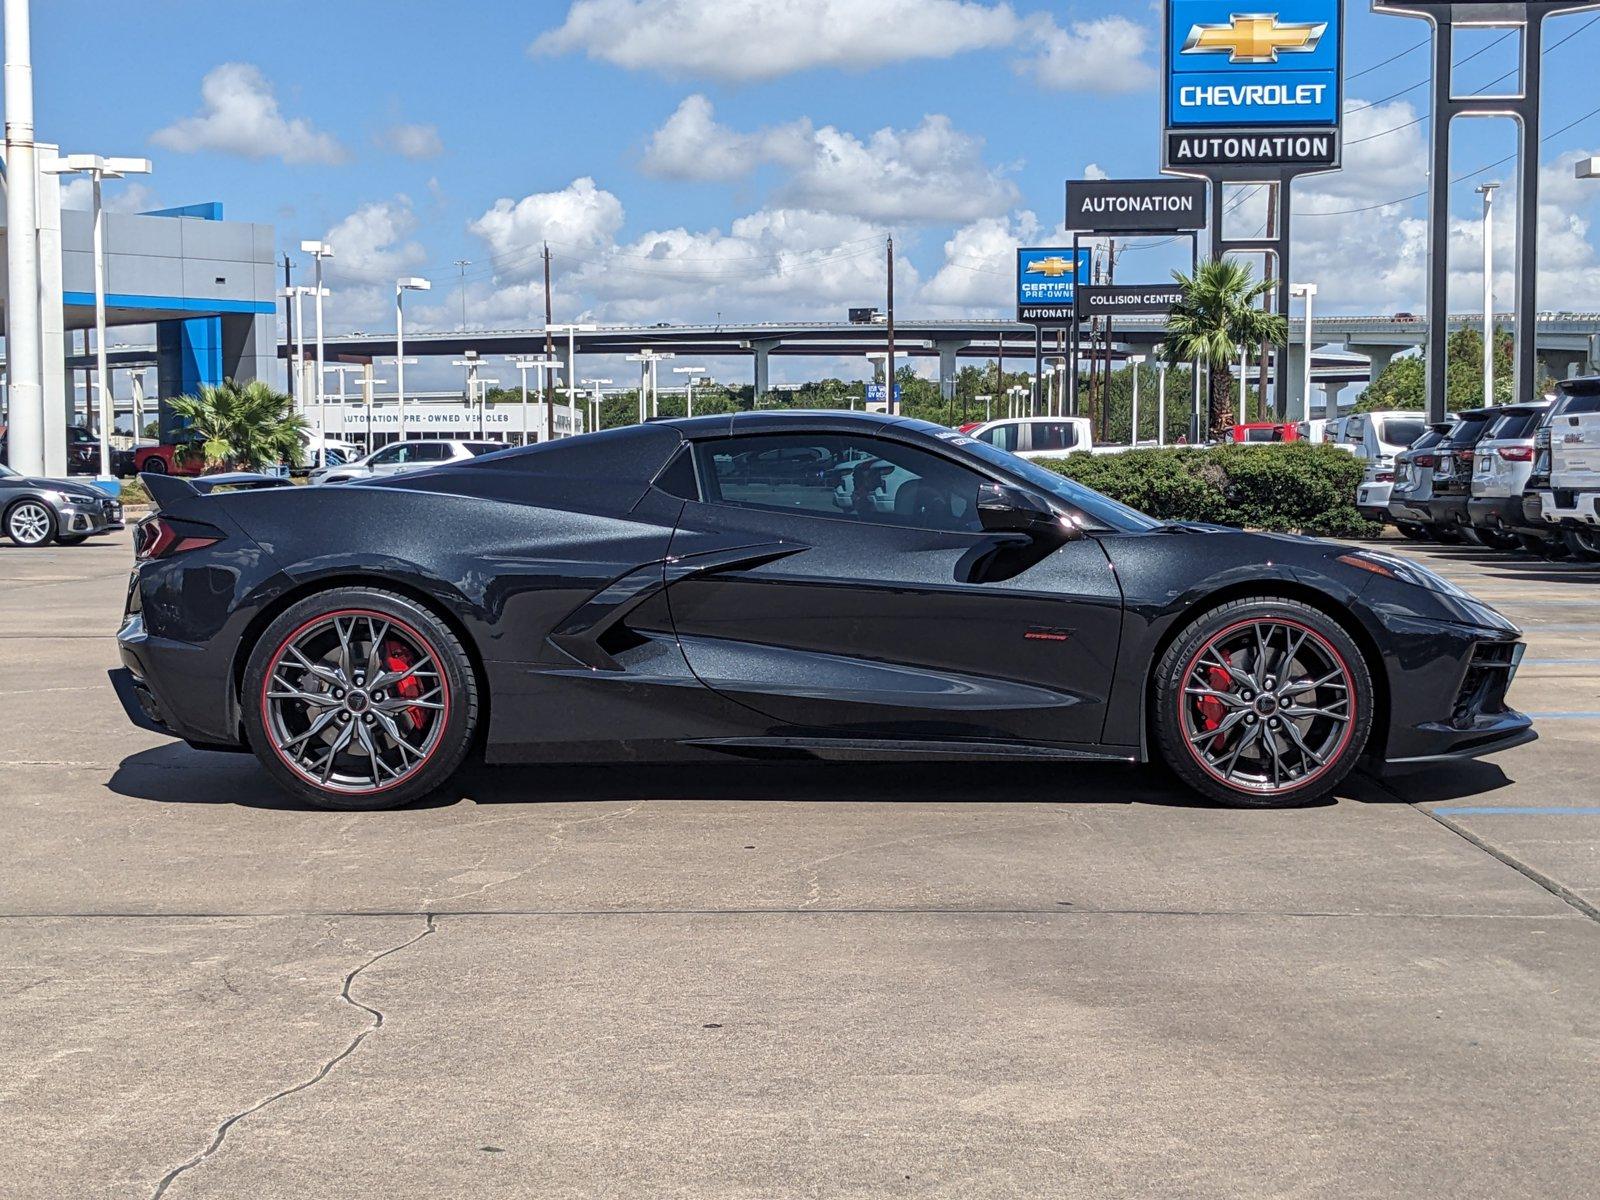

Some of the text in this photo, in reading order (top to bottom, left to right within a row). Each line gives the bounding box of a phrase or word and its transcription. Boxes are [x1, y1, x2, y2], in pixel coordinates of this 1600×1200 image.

[1180, 84, 1327, 106] CHEVROLET
[1177, 137, 1328, 158] AUTONATION
[1081, 196, 1193, 213] AUTONATION
[1021, 283, 1086, 291] CERTIFIE
[1090, 294, 1182, 305] COLLISION CENTER
[465, 414, 509, 422] VEHCLES
